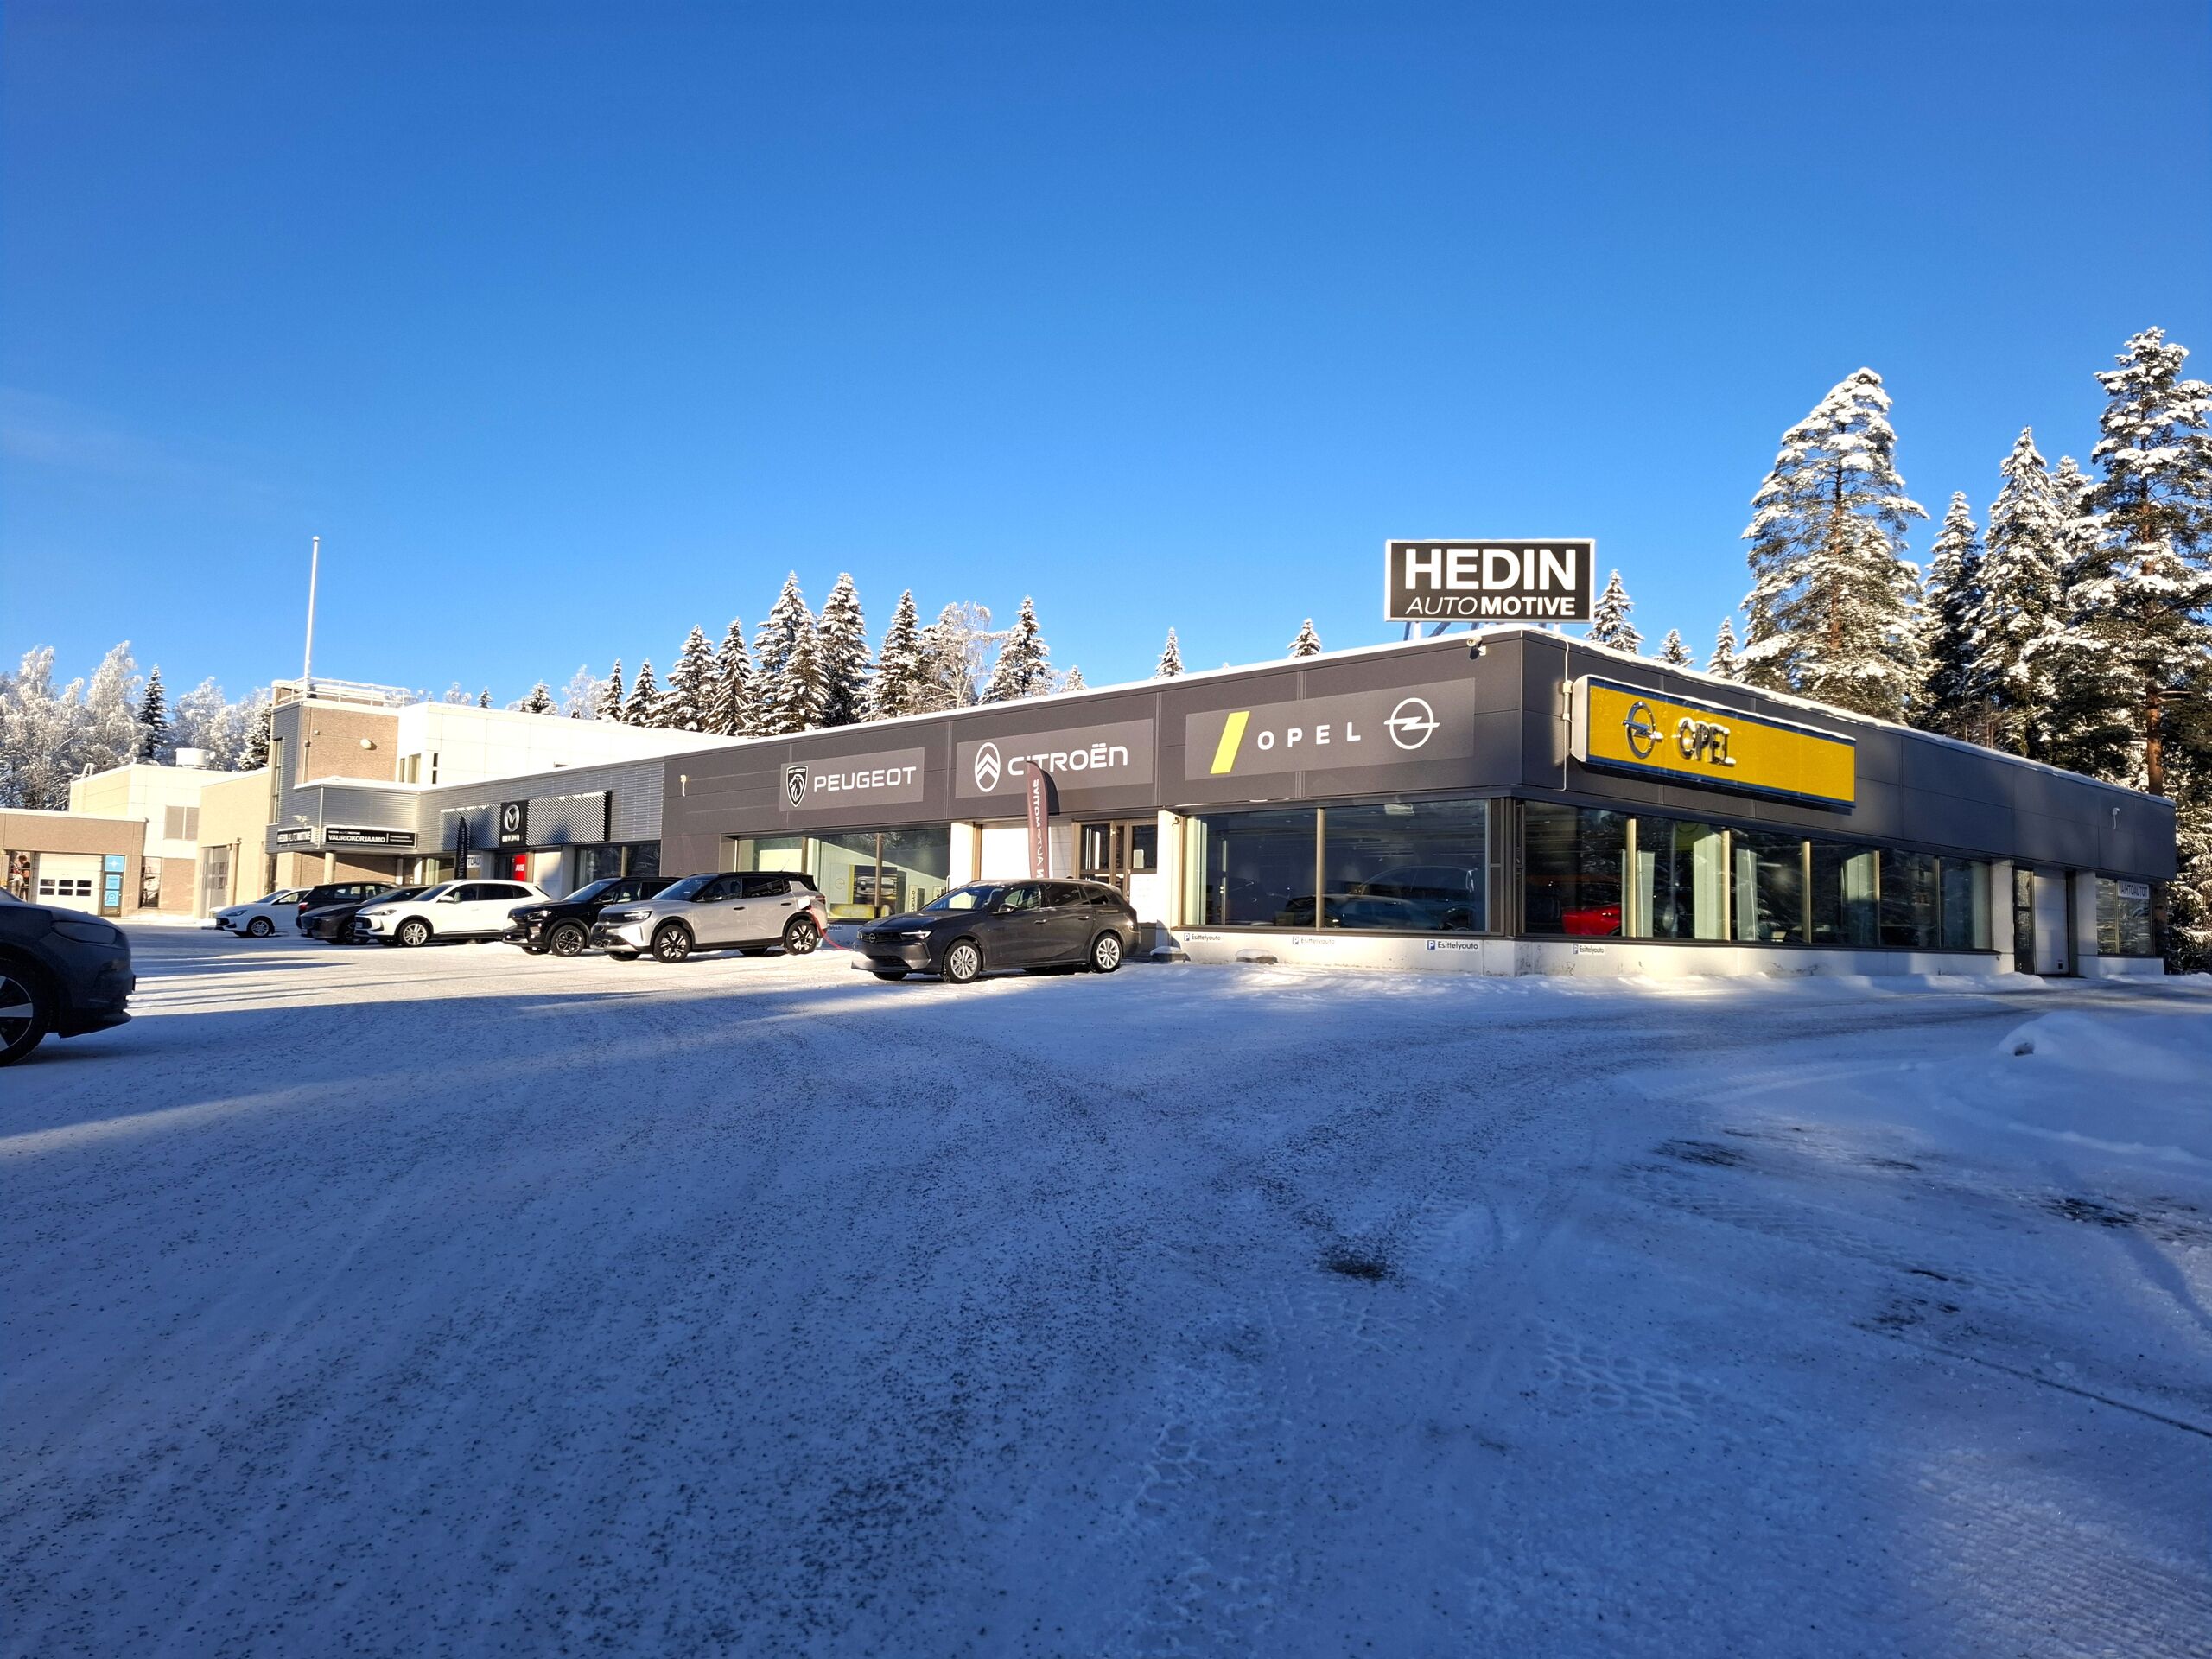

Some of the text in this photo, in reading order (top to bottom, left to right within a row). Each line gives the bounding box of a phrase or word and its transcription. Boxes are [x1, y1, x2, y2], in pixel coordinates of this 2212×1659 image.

[1405, 548, 1576, 591] HEDIN
[1405, 596, 1575, 616] AUTOMOTIVE
[1257, 721, 1362, 750] OPEL
[1678, 717, 1736, 767] OPEL
[814, 766, 917, 792] PEUGEOT
[1438, 941, 1478, 950] Esittelyauto
